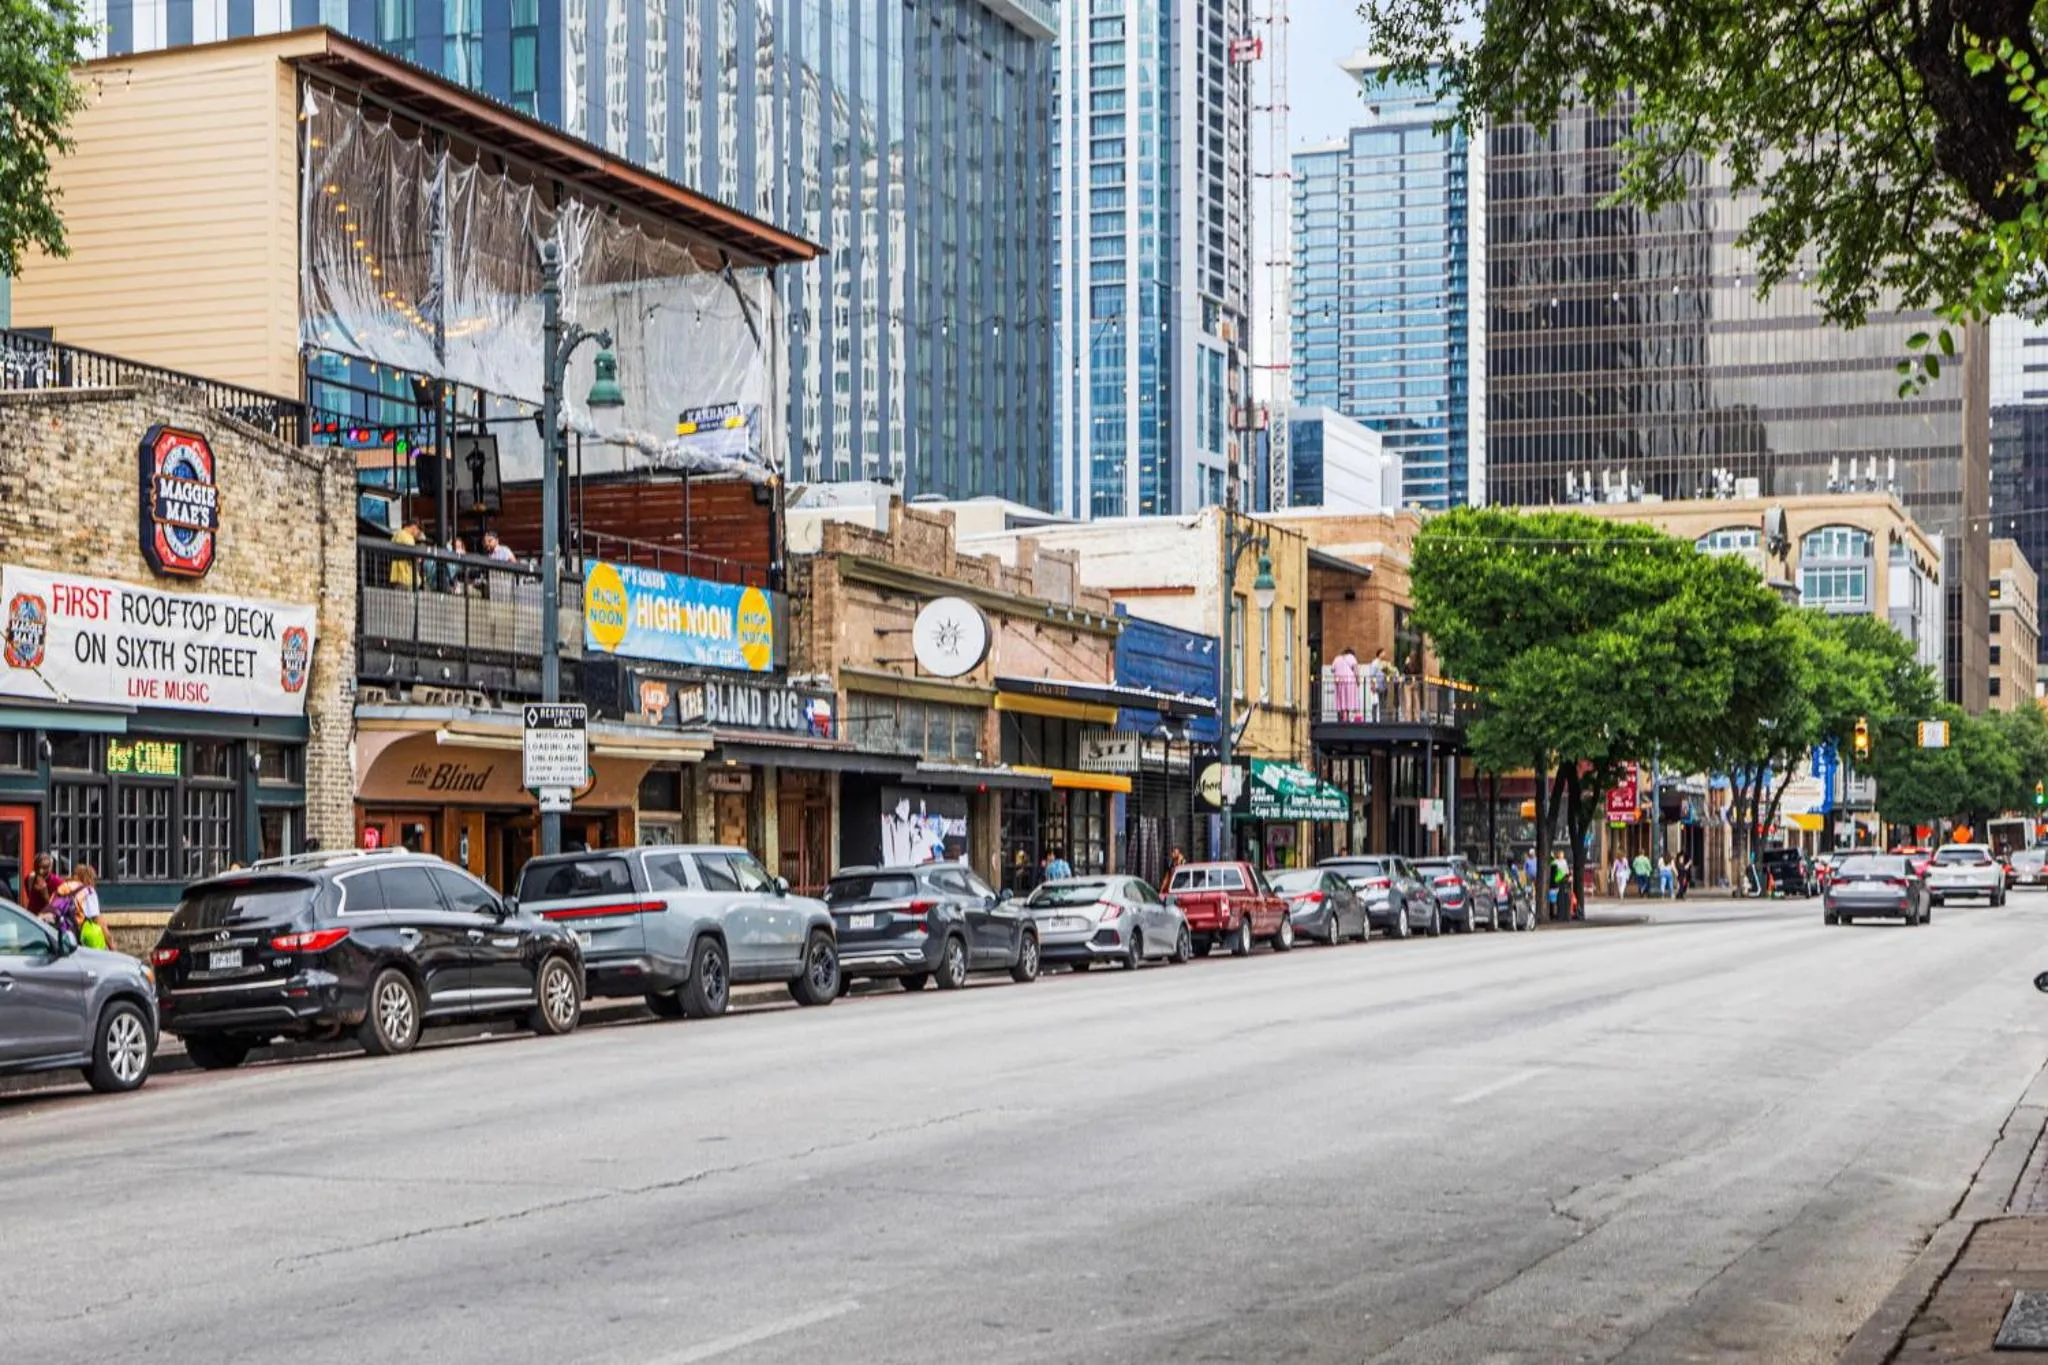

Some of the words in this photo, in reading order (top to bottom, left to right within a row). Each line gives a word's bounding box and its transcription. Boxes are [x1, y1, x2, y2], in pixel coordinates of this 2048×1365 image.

[160, 478, 216, 508] MAGGIE
[165, 500, 210, 529] MAE'S
[592, 589, 621, 606] HIGH
[51, 583, 112, 620] FIRST
[121, 593, 217, 633] ROOFTOP
[224, 607, 276, 641] DECK
[589, 608, 623, 626] NOON
[636, 592, 681, 634] HIGH
[685, 601, 732, 641] NOON
[743, 612, 766, 626] HIGH
[741, 631, 771, 646] NOON
[75, 632, 106, 665] ON
[116, 636, 175, 671] SIXTH
[184, 645, 258, 678] STREET
[128, 678, 158, 699] LIVE
[164, 681, 210, 703] MUSIC
[540, 707, 585, 719] RESTRICTED
[679, 686, 704, 724] THE
[705, 681, 762, 726] BLIND
[767, 688, 799, 729] PIG
[554, 717, 573, 728] LANE
[536, 732, 575, 740] MUSICIAN
[134, 740, 177, 775] COME
[528, 743, 563, 751] LOADING
[566, 743, 583, 751] AND
[532, 754, 579, 763] UNLOADING
[410, 763, 432, 779] the
[428, 762, 495, 792] Blind
